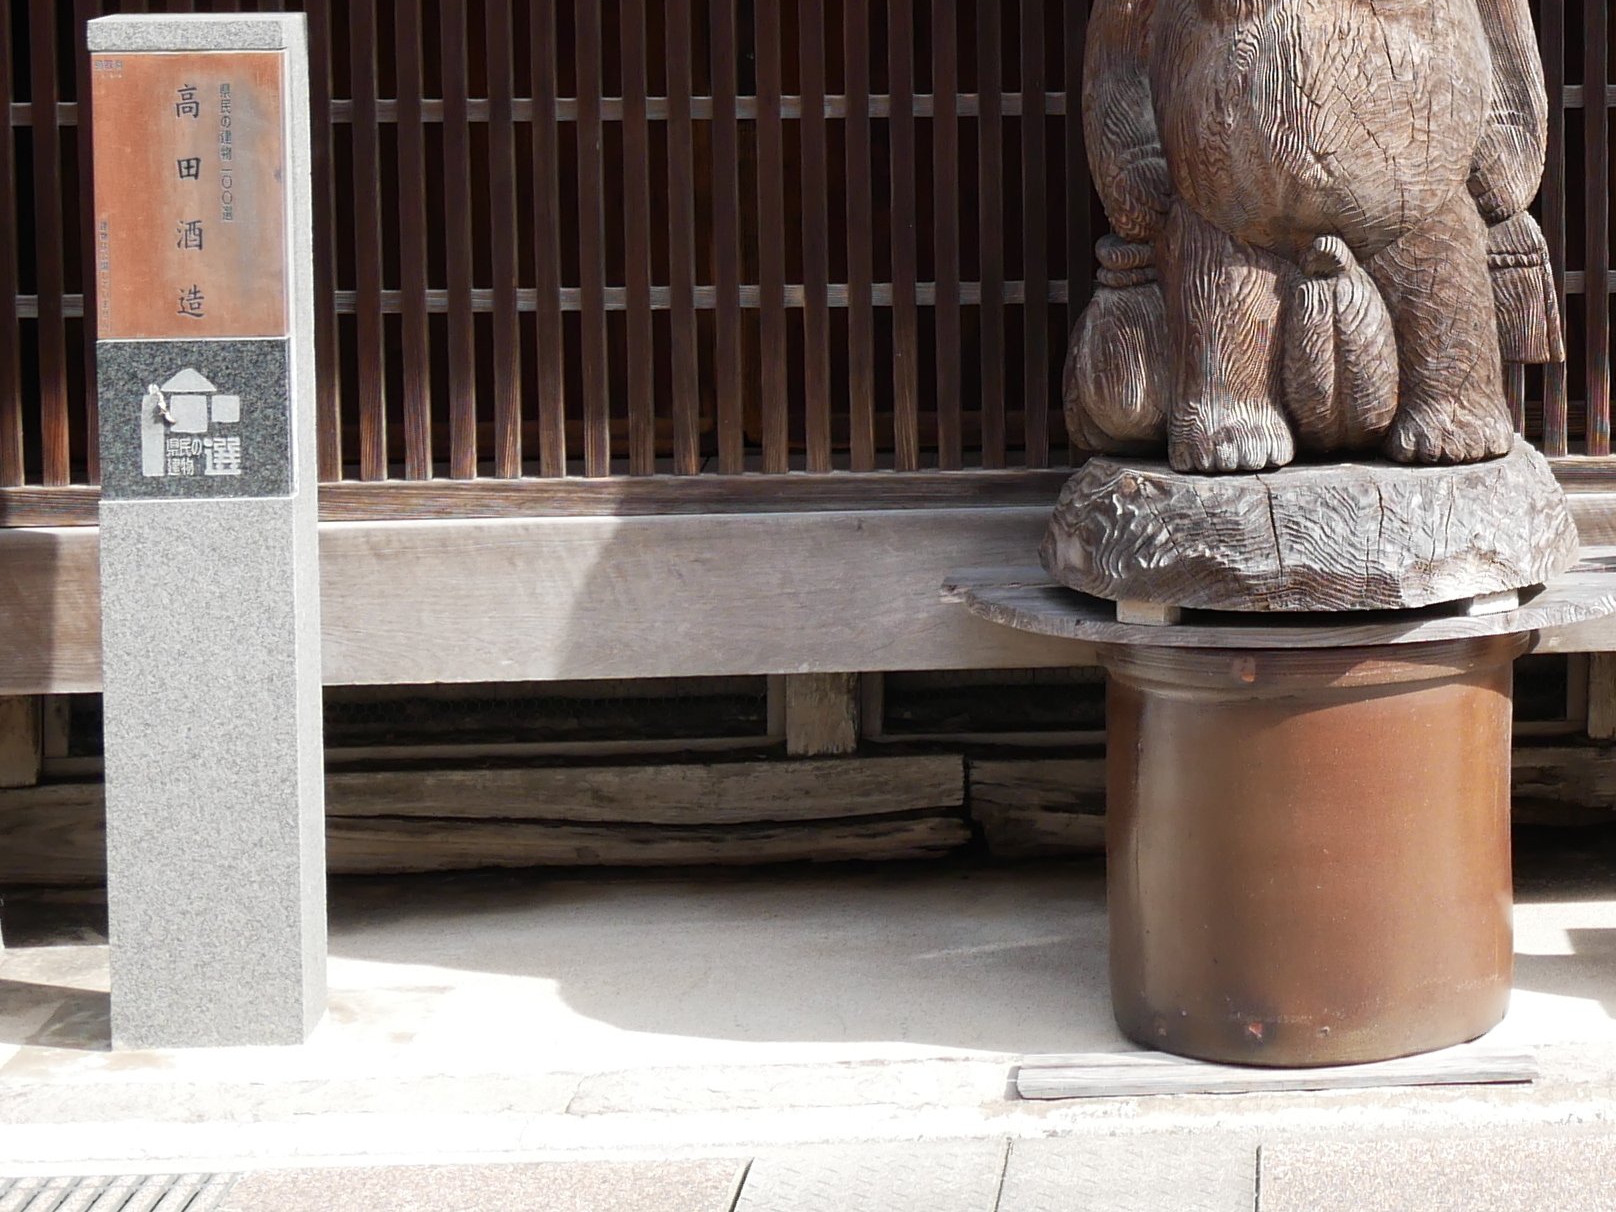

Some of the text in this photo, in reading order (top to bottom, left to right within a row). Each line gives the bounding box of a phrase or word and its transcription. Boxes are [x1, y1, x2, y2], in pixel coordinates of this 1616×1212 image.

[175, 84, 204, 317] 高田酒造
[166, 438, 202, 457] 県民の
[203, 437, 241, 475] 選
[167, 457, 195, 476] 建物
